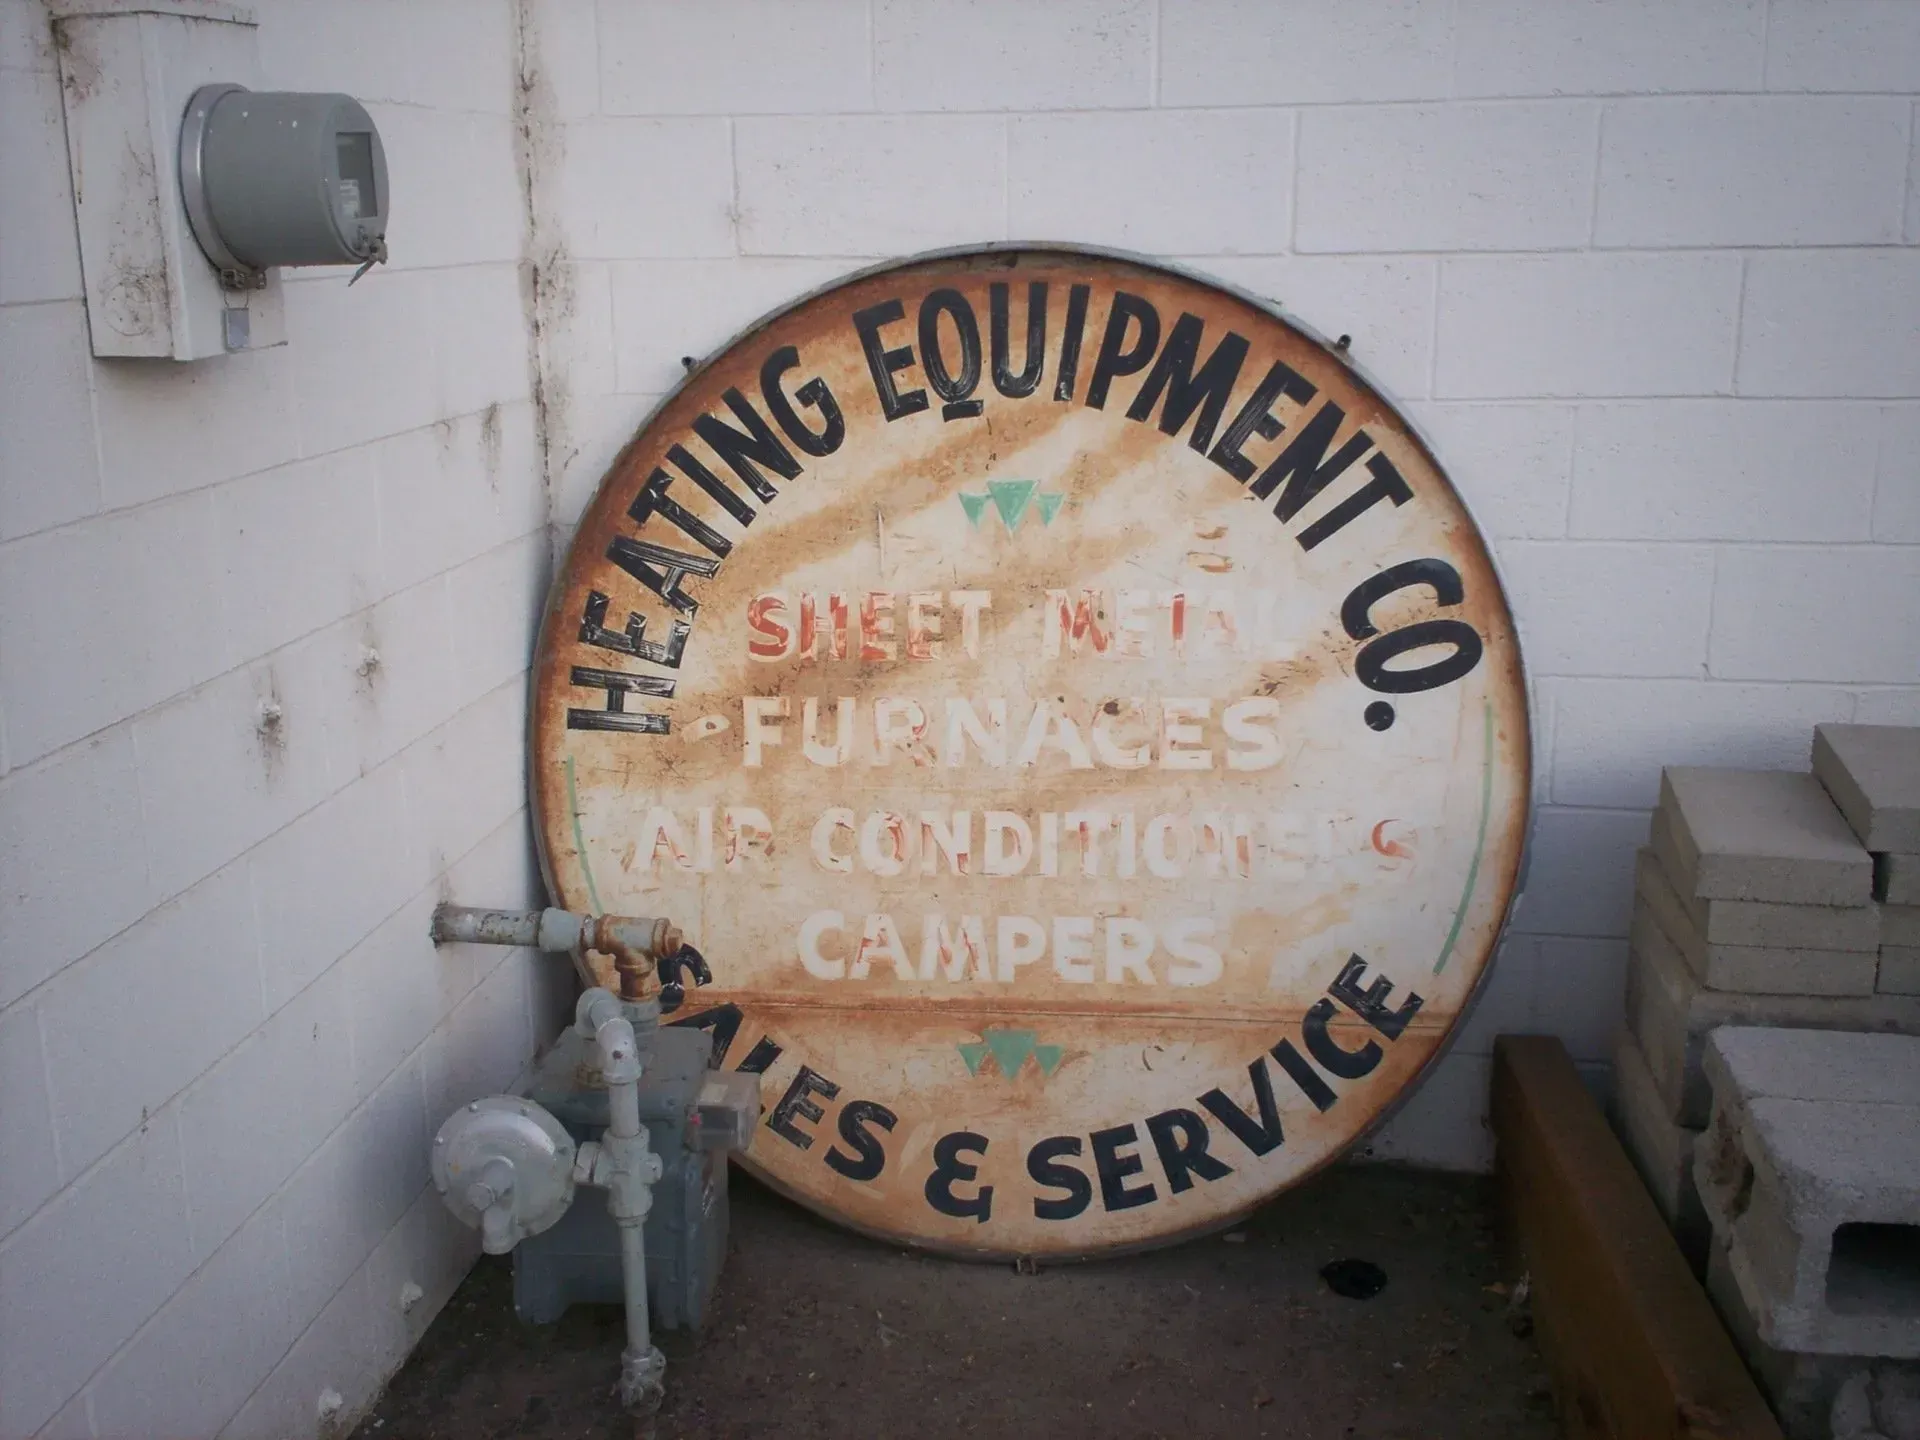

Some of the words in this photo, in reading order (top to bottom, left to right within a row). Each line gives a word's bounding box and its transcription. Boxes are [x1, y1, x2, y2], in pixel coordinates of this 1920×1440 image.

[567, 345, 846, 735] HEATING
[852, 281, 1414, 553] EQUIPMENT
[1340, 558, 1483, 732] CO.
[746, 589, 992, 662] SHEET
[742, 695, 1286, 771] FURNACES
[624, 805, 775, 873] AIR
[797, 909, 1224, 987] CAMPERS
[924, 1131, 994, 1224] &
[1026, 951, 1424, 1221] SERVICE
